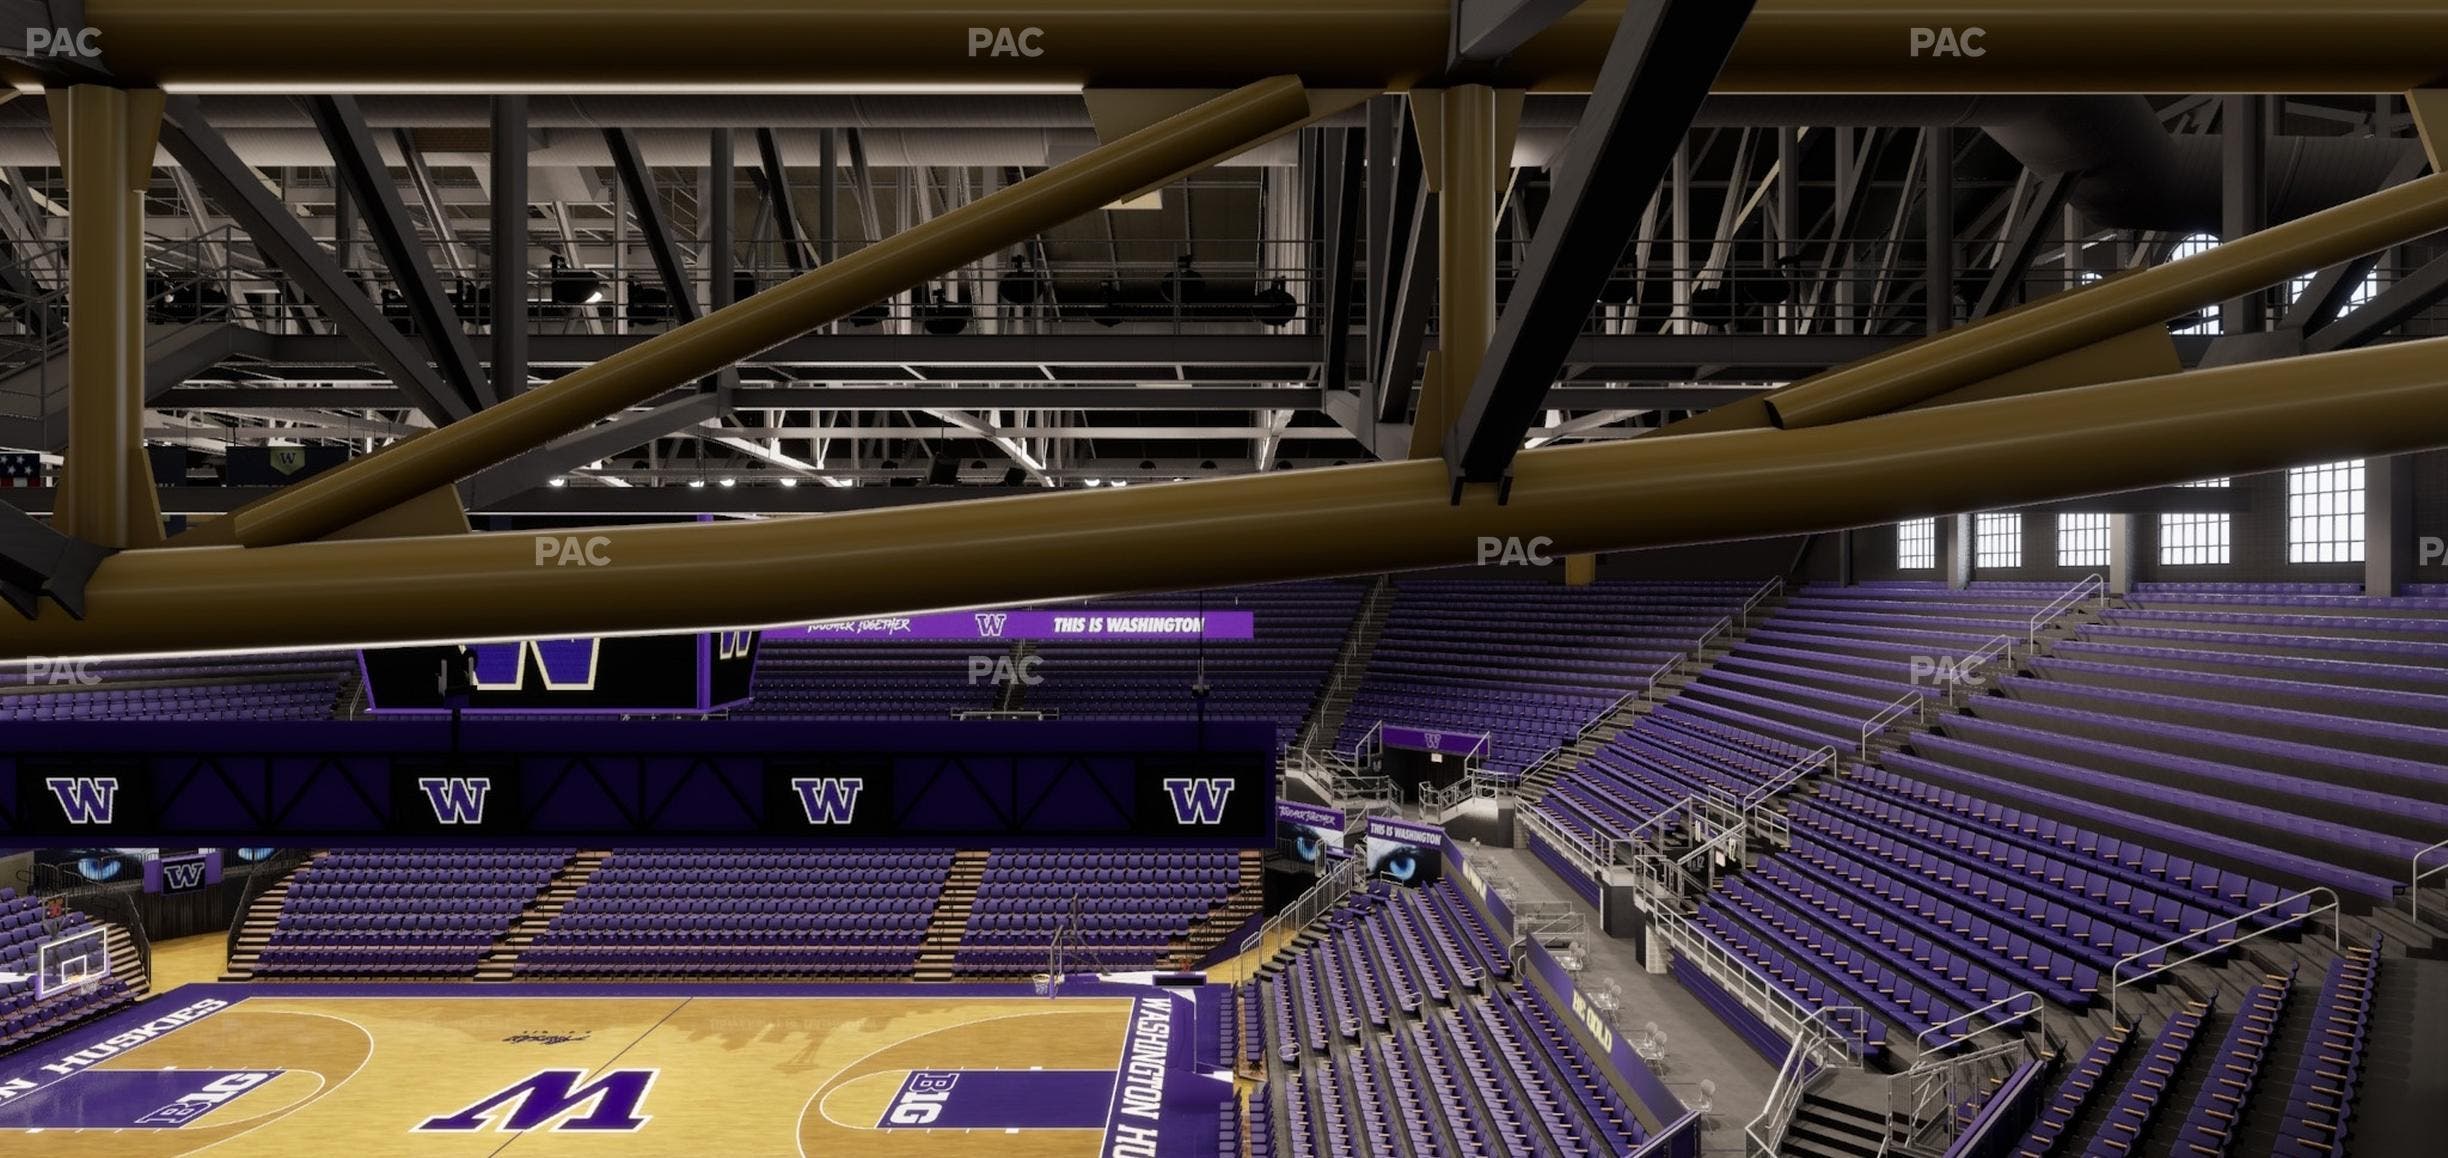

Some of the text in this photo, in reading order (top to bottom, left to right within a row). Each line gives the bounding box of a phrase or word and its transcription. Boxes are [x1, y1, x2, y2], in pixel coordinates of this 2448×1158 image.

[975, 614, 1007, 637] W
[1054, 617, 1205, 632] THIS IS WASHINGTON
[46, 778, 118, 824] W
[419, 778, 491, 824] W
[792, 778, 864, 824] W
[1164, 778, 1236, 824] W
[1370, 822, 1441, 846] THIS IS WASHINGTON
[163, 863, 205, 890] W
[41, 998, 229, 1075] HUSKIES
[1120, 998, 1172, 1120] WASHINGTON
[408, 1067, 662, 1133] W
